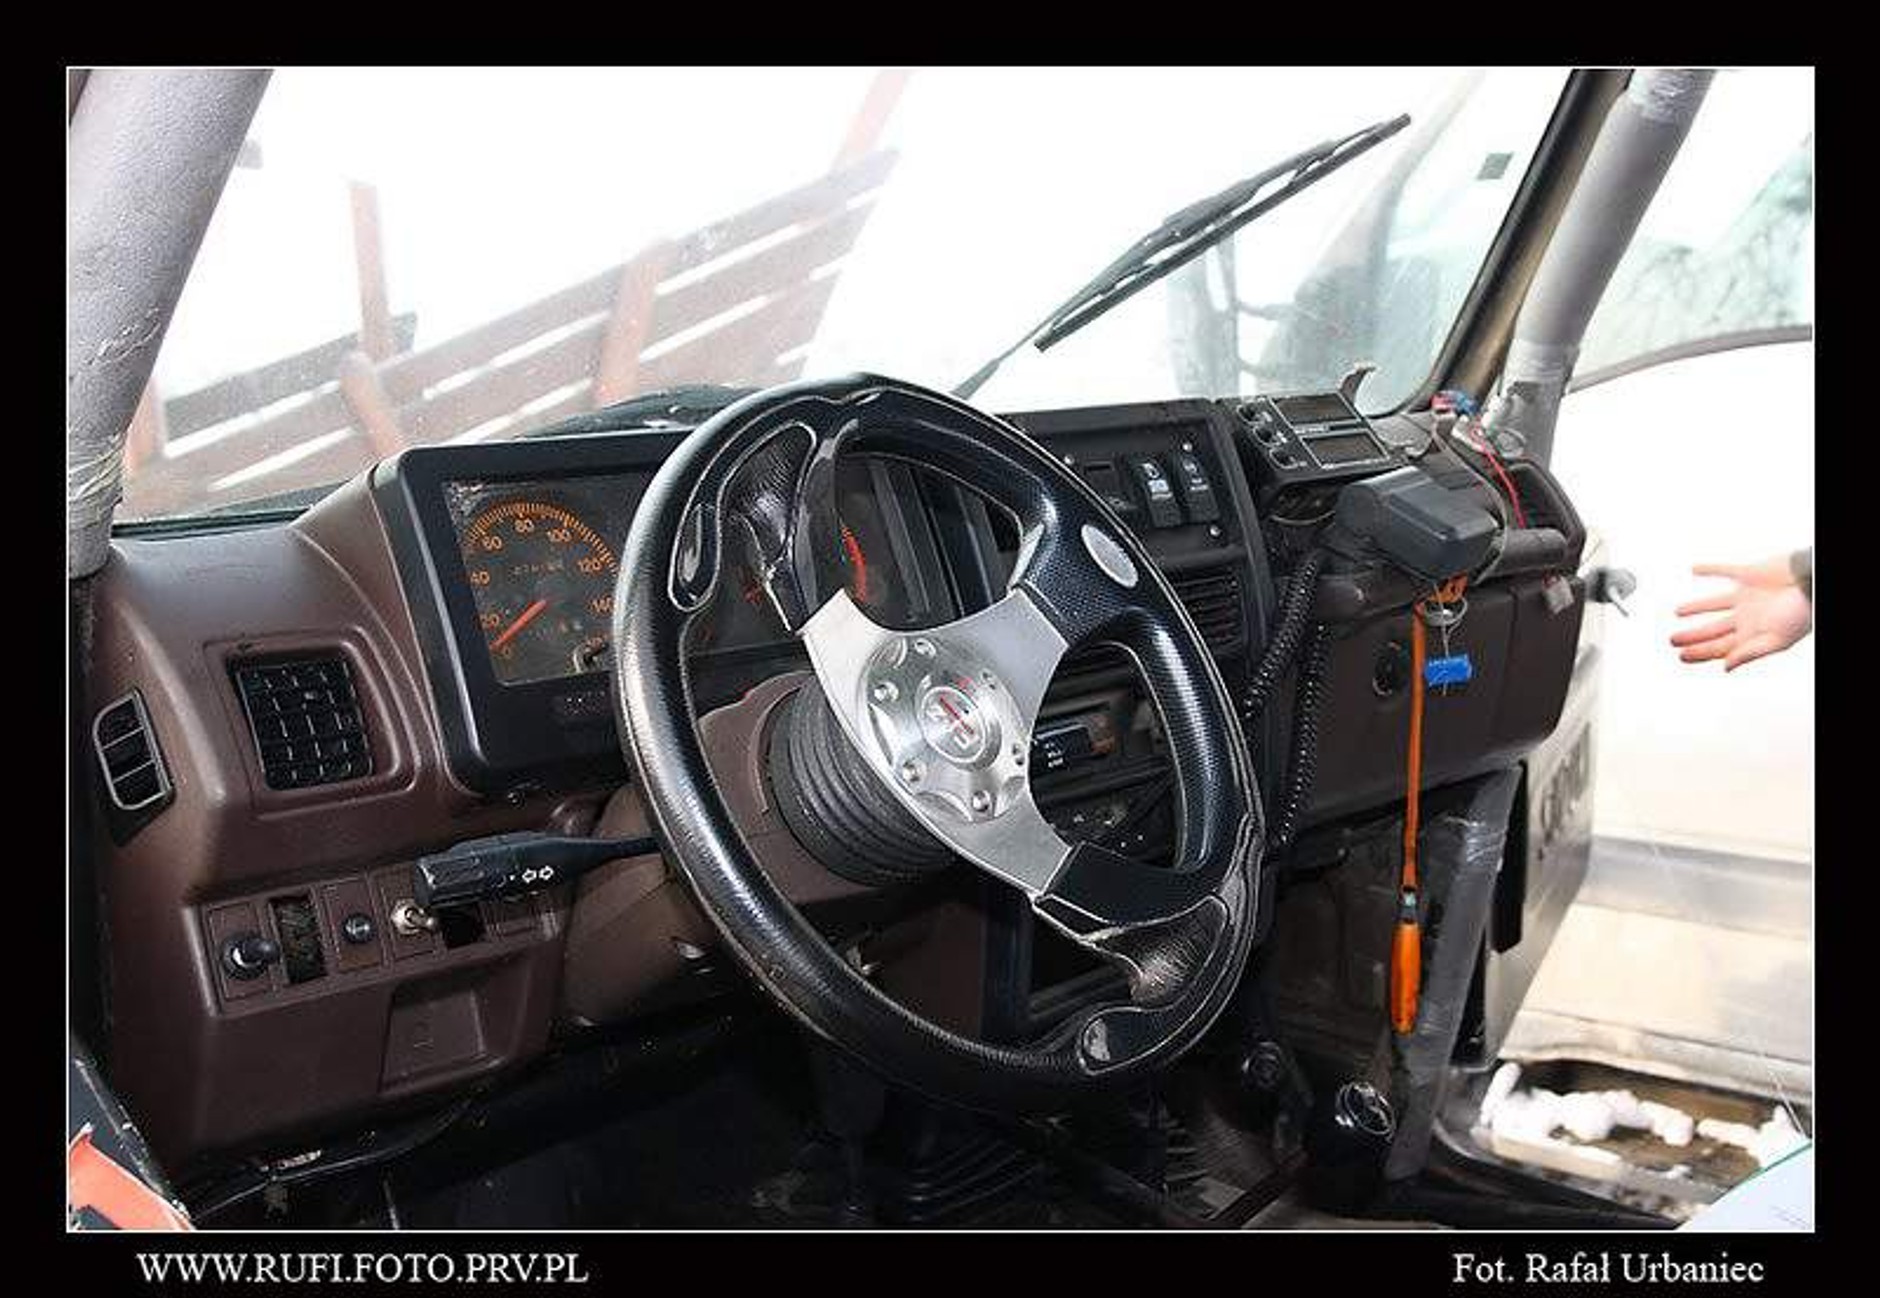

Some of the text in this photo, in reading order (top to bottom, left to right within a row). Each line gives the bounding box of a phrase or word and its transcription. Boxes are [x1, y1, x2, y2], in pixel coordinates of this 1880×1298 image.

[515, 519, 534, 533] 80
[578, 560, 601, 573] 120
[470, 572, 490, 584] 40
